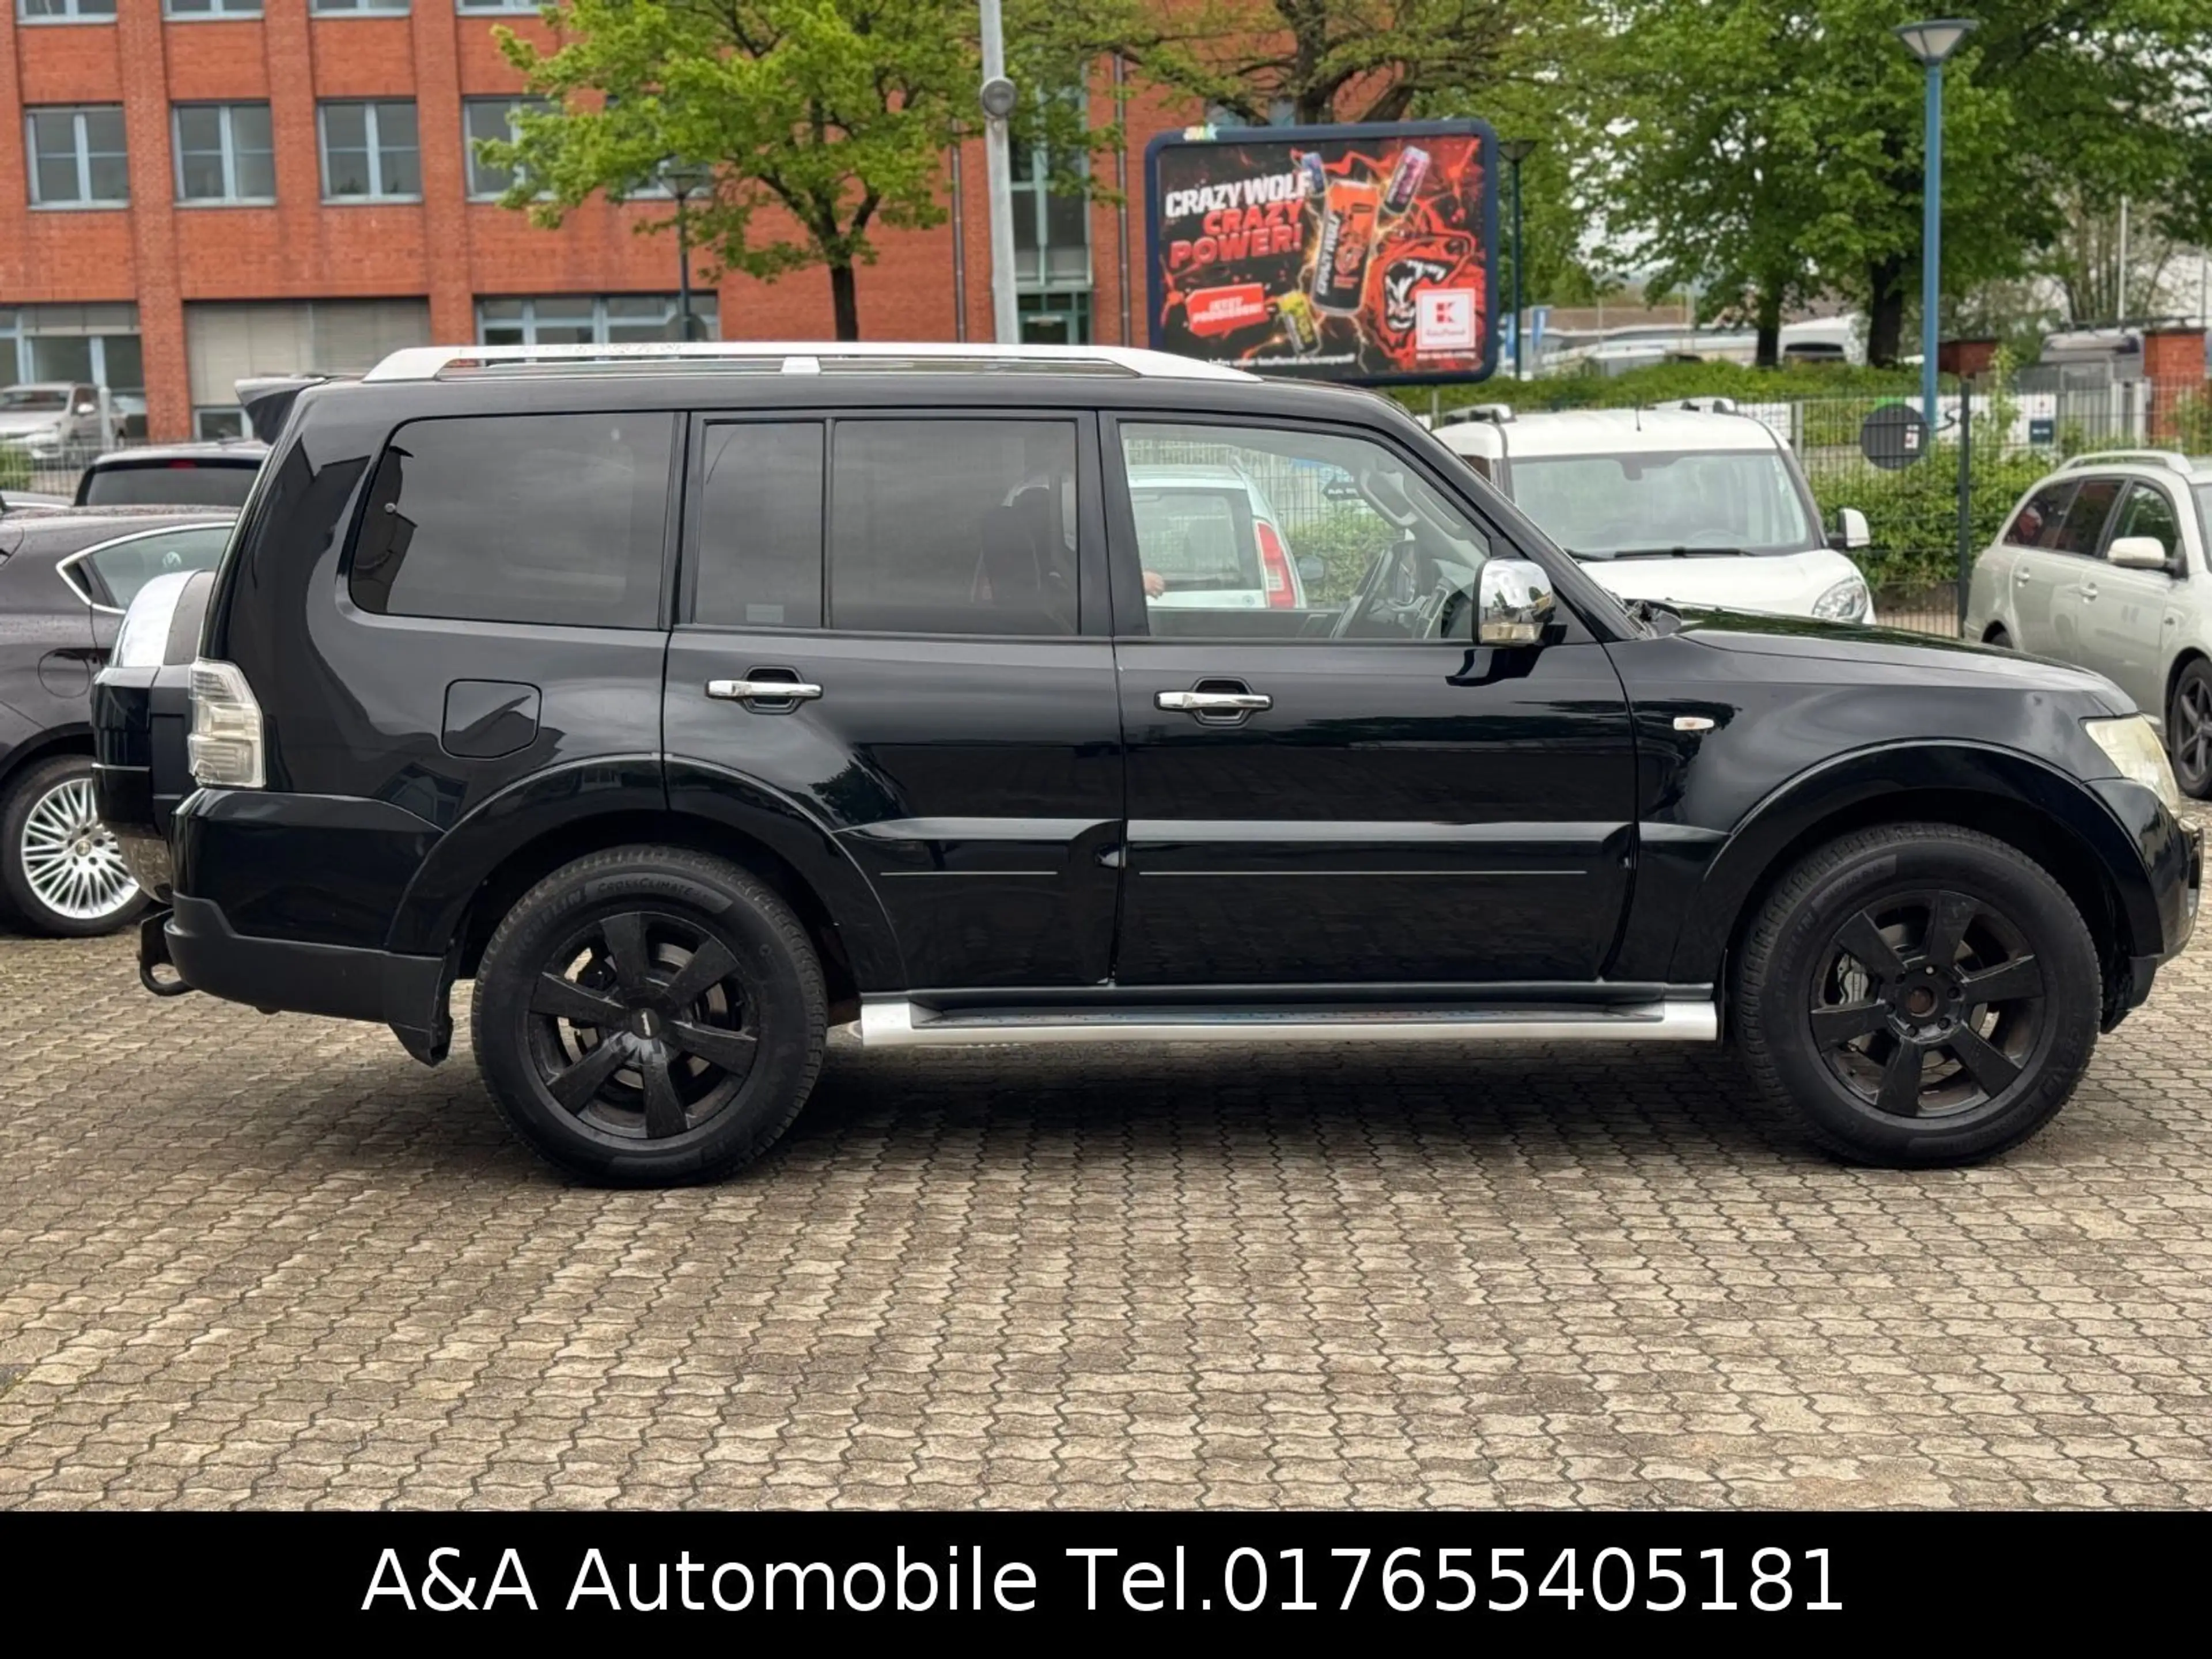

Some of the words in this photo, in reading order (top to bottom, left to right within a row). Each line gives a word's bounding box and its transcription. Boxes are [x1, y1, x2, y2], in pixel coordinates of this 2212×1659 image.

[1165, 181, 1242, 218] CRAZY
[1244, 169, 1312, 206] WOLF
[1203, 198, 1304, 236] CRAZY
[1169, 222, 1303, 269] POWER!
